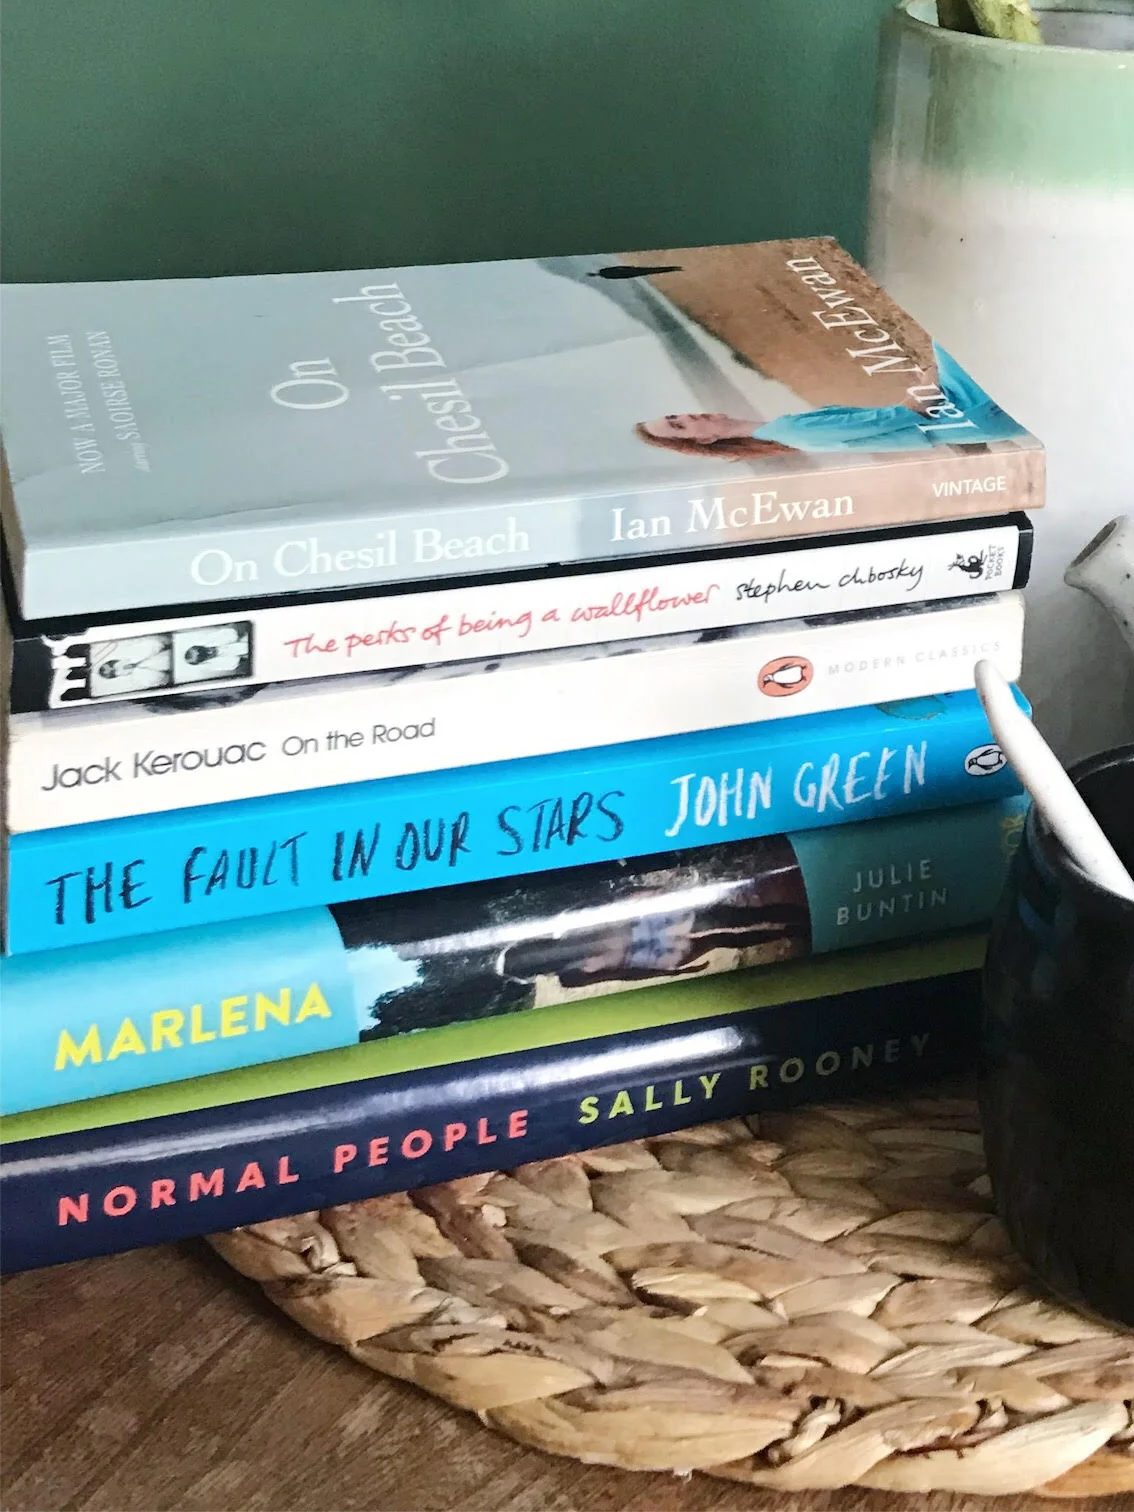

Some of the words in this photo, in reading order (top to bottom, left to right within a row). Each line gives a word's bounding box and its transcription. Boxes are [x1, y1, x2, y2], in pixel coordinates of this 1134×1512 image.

[332, 282, 448, 373] Beach
[787, 256, 926, 377] McEwan
[47, 334, 76, 367] FILM
[86, 331, 121, 377] RONAN
[56, 371, 92, 419] MAJOR
[270, 357, 349, 410] On
[907, 383, 979, 433] Ian
[70, 423, 96, 432] A
[101, 381, 141, 440] SAOIRSE
[379, 378, 510, 484] Chesil
[73, 438, 106, 474] NOW
[190, 549, 259, 586] On
[273, 530, 397, 576] Chesil
[413, 517, 530, 562] Beach
[610, 508, 672, 542] Ian
[687, 490, 855, 534] McEwan
[932, 476, 1008, 499] VINTAGE
[985, 544, 997, 580] POCKET
[994, 546, 1005, 577] BOOKS
[283, 634, 339, 658] The
[344, 620, 417, 658] perks
[421, 614, 455, 646] of
[457, 610, 533, 638] being
[541, 607, 561, 624] a
[570, 585, 720, 623] wallflower
[735, 570, 832, 602] stephen
[828, 655, 906, 676] MODERN
[915, 641, 1001, 662] CLASSICS
[41, 758, 123, 792] Jack
[132, 736, 267, 779] Kerouac
[282, 735, 319, 758] On
[327, 728, 365, 750] the
[372, 717, 437, 745] Road
[46, 858, 153, 925] THE
[183, 831, 308, 904] FAULT
[331, 821, 381, 882] IN
[396, 811, 471, 871] OUR
[497, 789, 625, 857] STARS
[665, 762, 775, 838] JOHN
[793, 740, 928, 813] GREEN
[852, 859, 934, 894] JULIE
[836, 887, 949, 927] BUNTIN
[53, 982, 332, 1071] MARLENA
[58, 1155, 300, 1227] NORMAL
[333, 1109, 530, 1174] PEOPLE
[578, 1071, 722, 1126] SALLY
[750, 1032, 931, 1091] ROONEY
